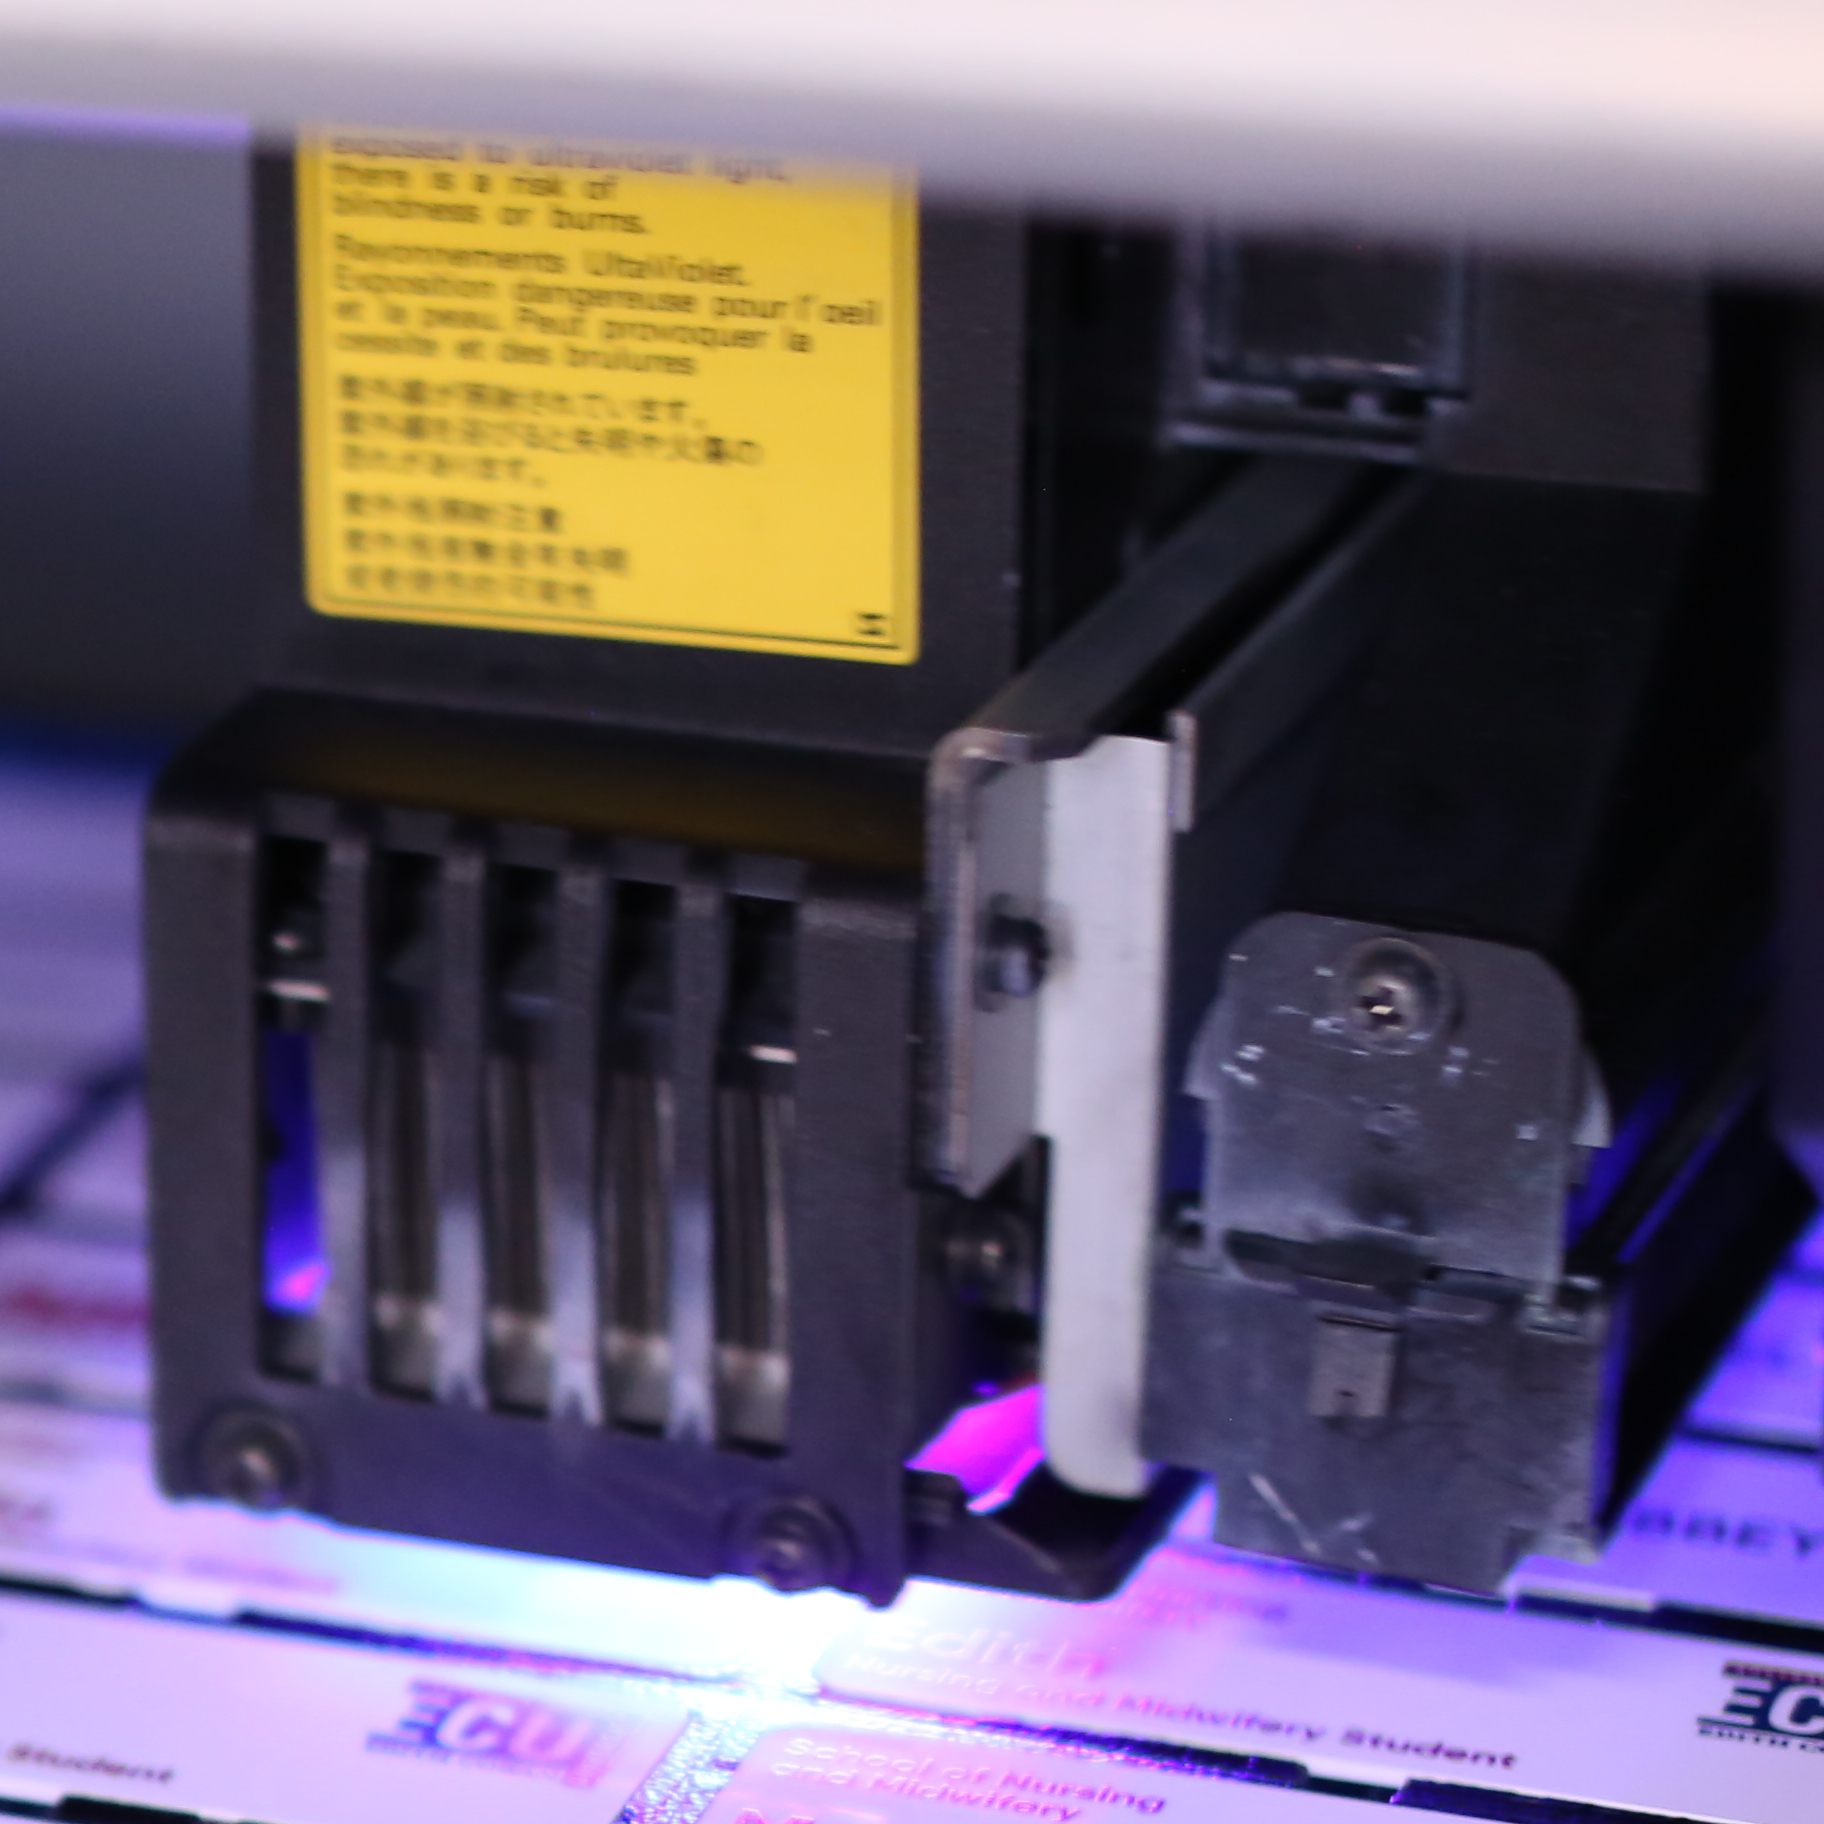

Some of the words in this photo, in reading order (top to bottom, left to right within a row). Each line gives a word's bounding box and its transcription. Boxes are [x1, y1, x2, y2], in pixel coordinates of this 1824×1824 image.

[1114, 1691, 1326, 1745] Midwifery
[1342, 1730, 1519, 1772] Student
[1705, 1678, 1824, 1736] EC
[771, 1760, 862, 1787] and
[866, 1770, 1082, 1824] Midwifery
[782, 1735, 942, 1781] School
[949, 1762, 998, 1787] of
[992, 1769, 1167, 1816] Nursing
